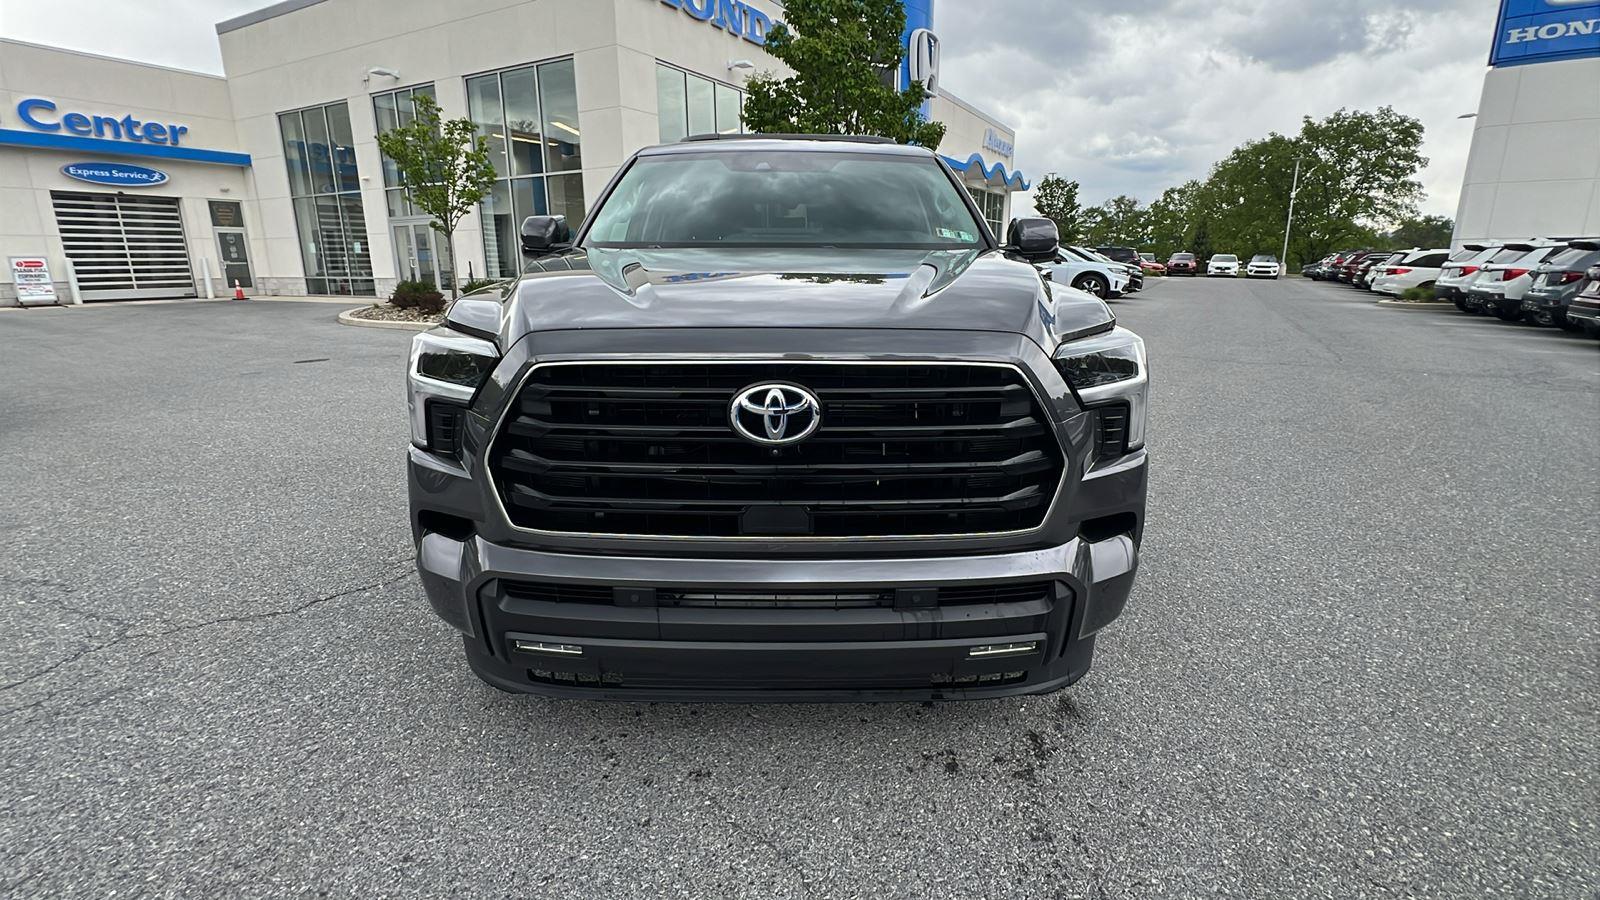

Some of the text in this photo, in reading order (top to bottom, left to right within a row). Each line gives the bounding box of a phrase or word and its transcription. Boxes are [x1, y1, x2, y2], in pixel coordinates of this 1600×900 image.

[1505, 19, 1600, 44] HON
[17, 98, 188, 146] Center
[69, 166, 149, 179] Express Service
